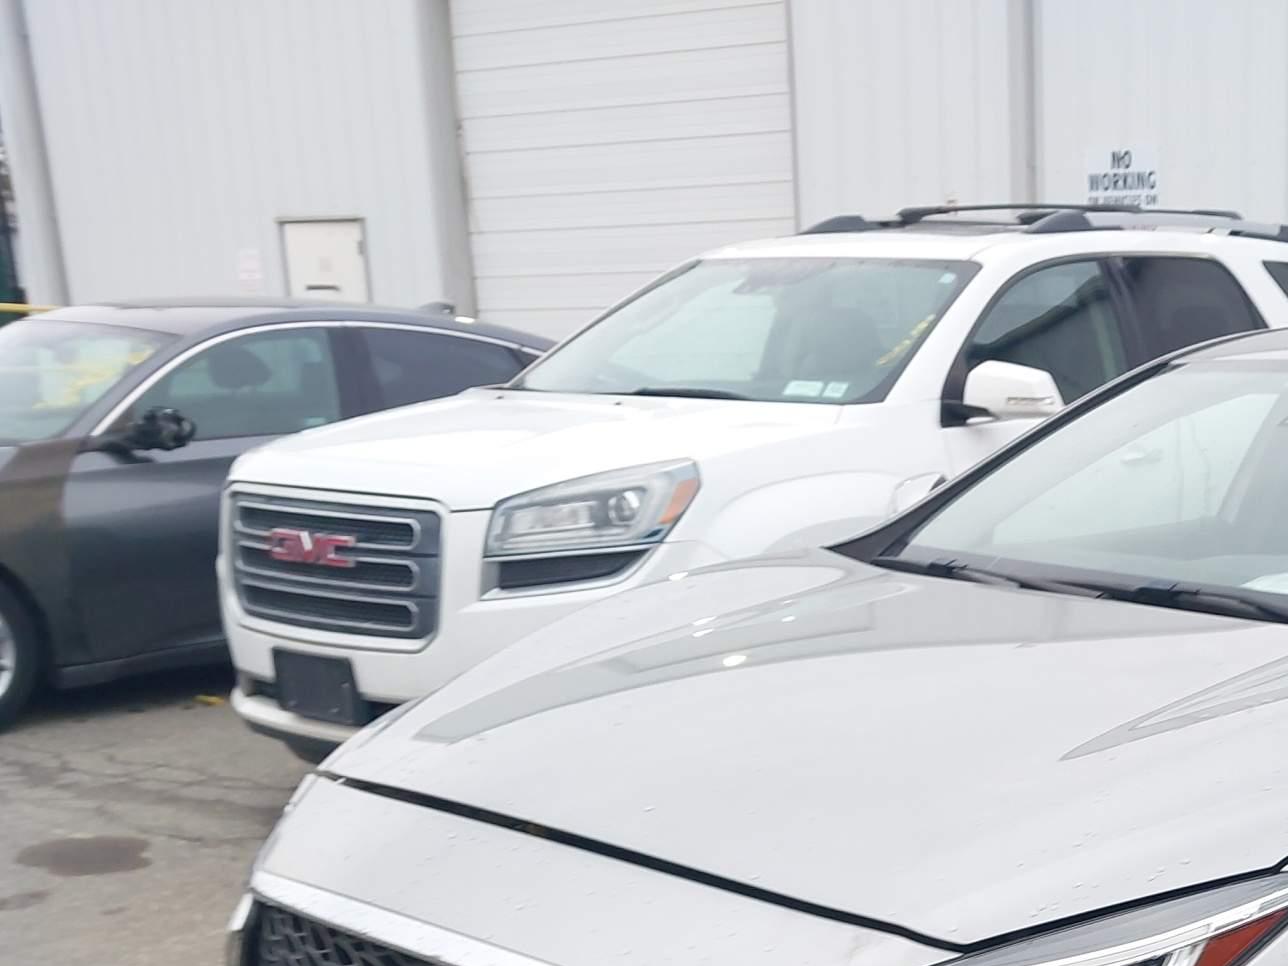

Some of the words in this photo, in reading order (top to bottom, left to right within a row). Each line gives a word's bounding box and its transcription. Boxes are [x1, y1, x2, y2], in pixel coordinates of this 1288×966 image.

[1111, 150, 1132, 170] NO
[1088, 171, 1157, 192] WORKING
[270, 528, 357, 568] GMC
